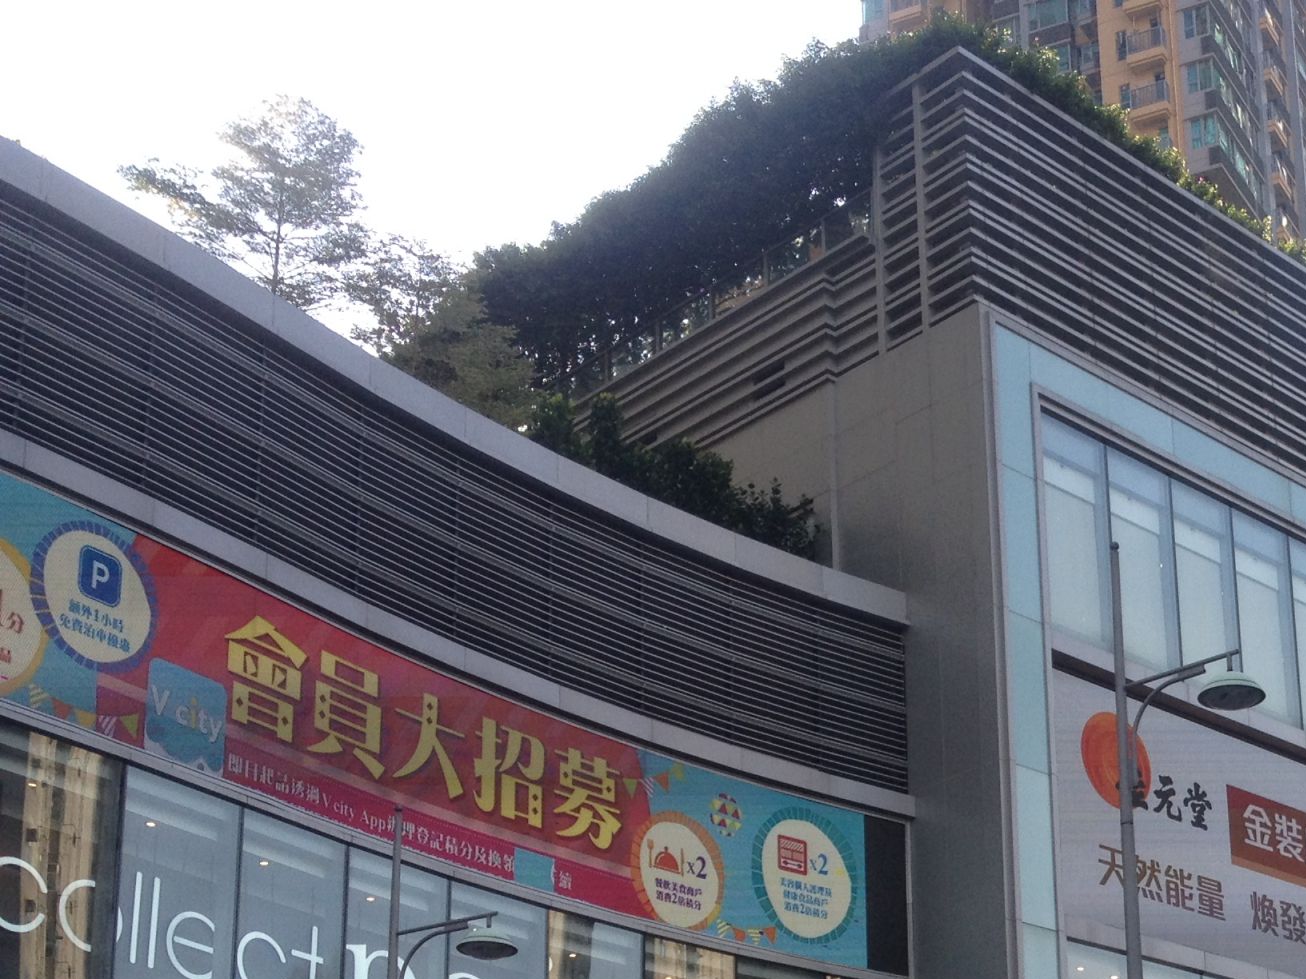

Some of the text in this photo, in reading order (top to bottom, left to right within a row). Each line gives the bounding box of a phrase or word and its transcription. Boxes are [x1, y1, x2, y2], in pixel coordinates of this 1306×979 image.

[225, 615, 622, 849] 會員大招募
[1098, 843, 1225, 921] 天然能量
